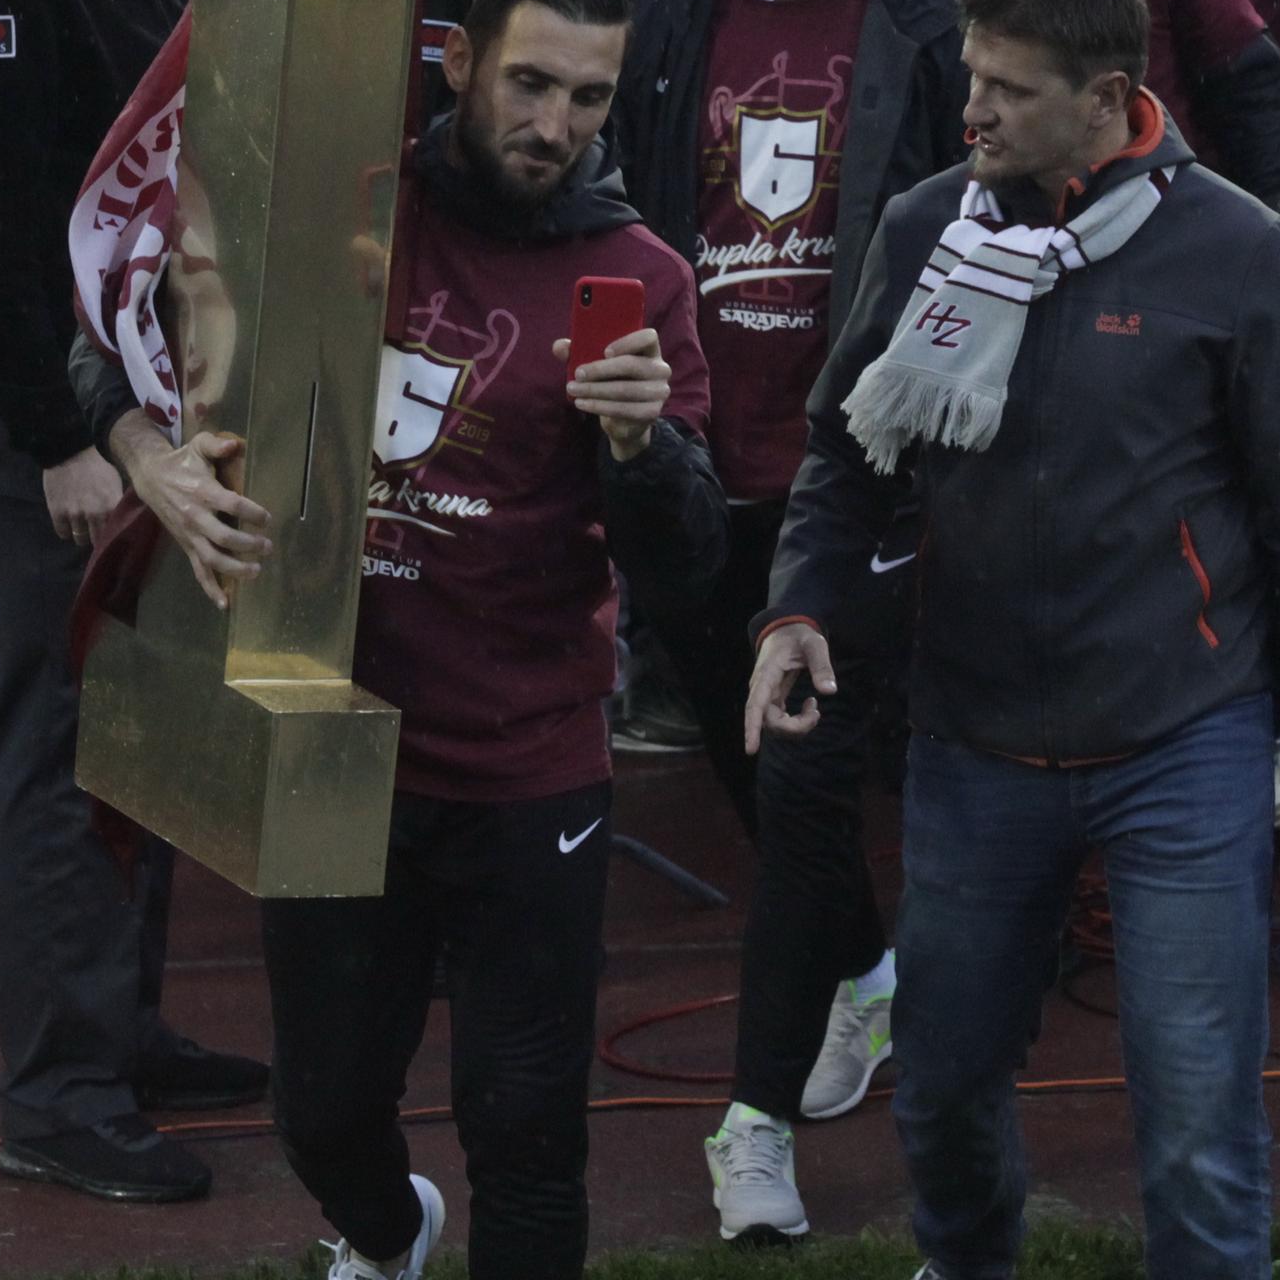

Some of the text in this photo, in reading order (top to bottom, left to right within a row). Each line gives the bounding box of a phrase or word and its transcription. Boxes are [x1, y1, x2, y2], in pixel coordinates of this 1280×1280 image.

[720, 308, 814, 332] SARAJEVO
[915, 302, 972, 349] HZ
[456, 420, 491, 442] 2019
[396, 477, 494, 518] kruna
